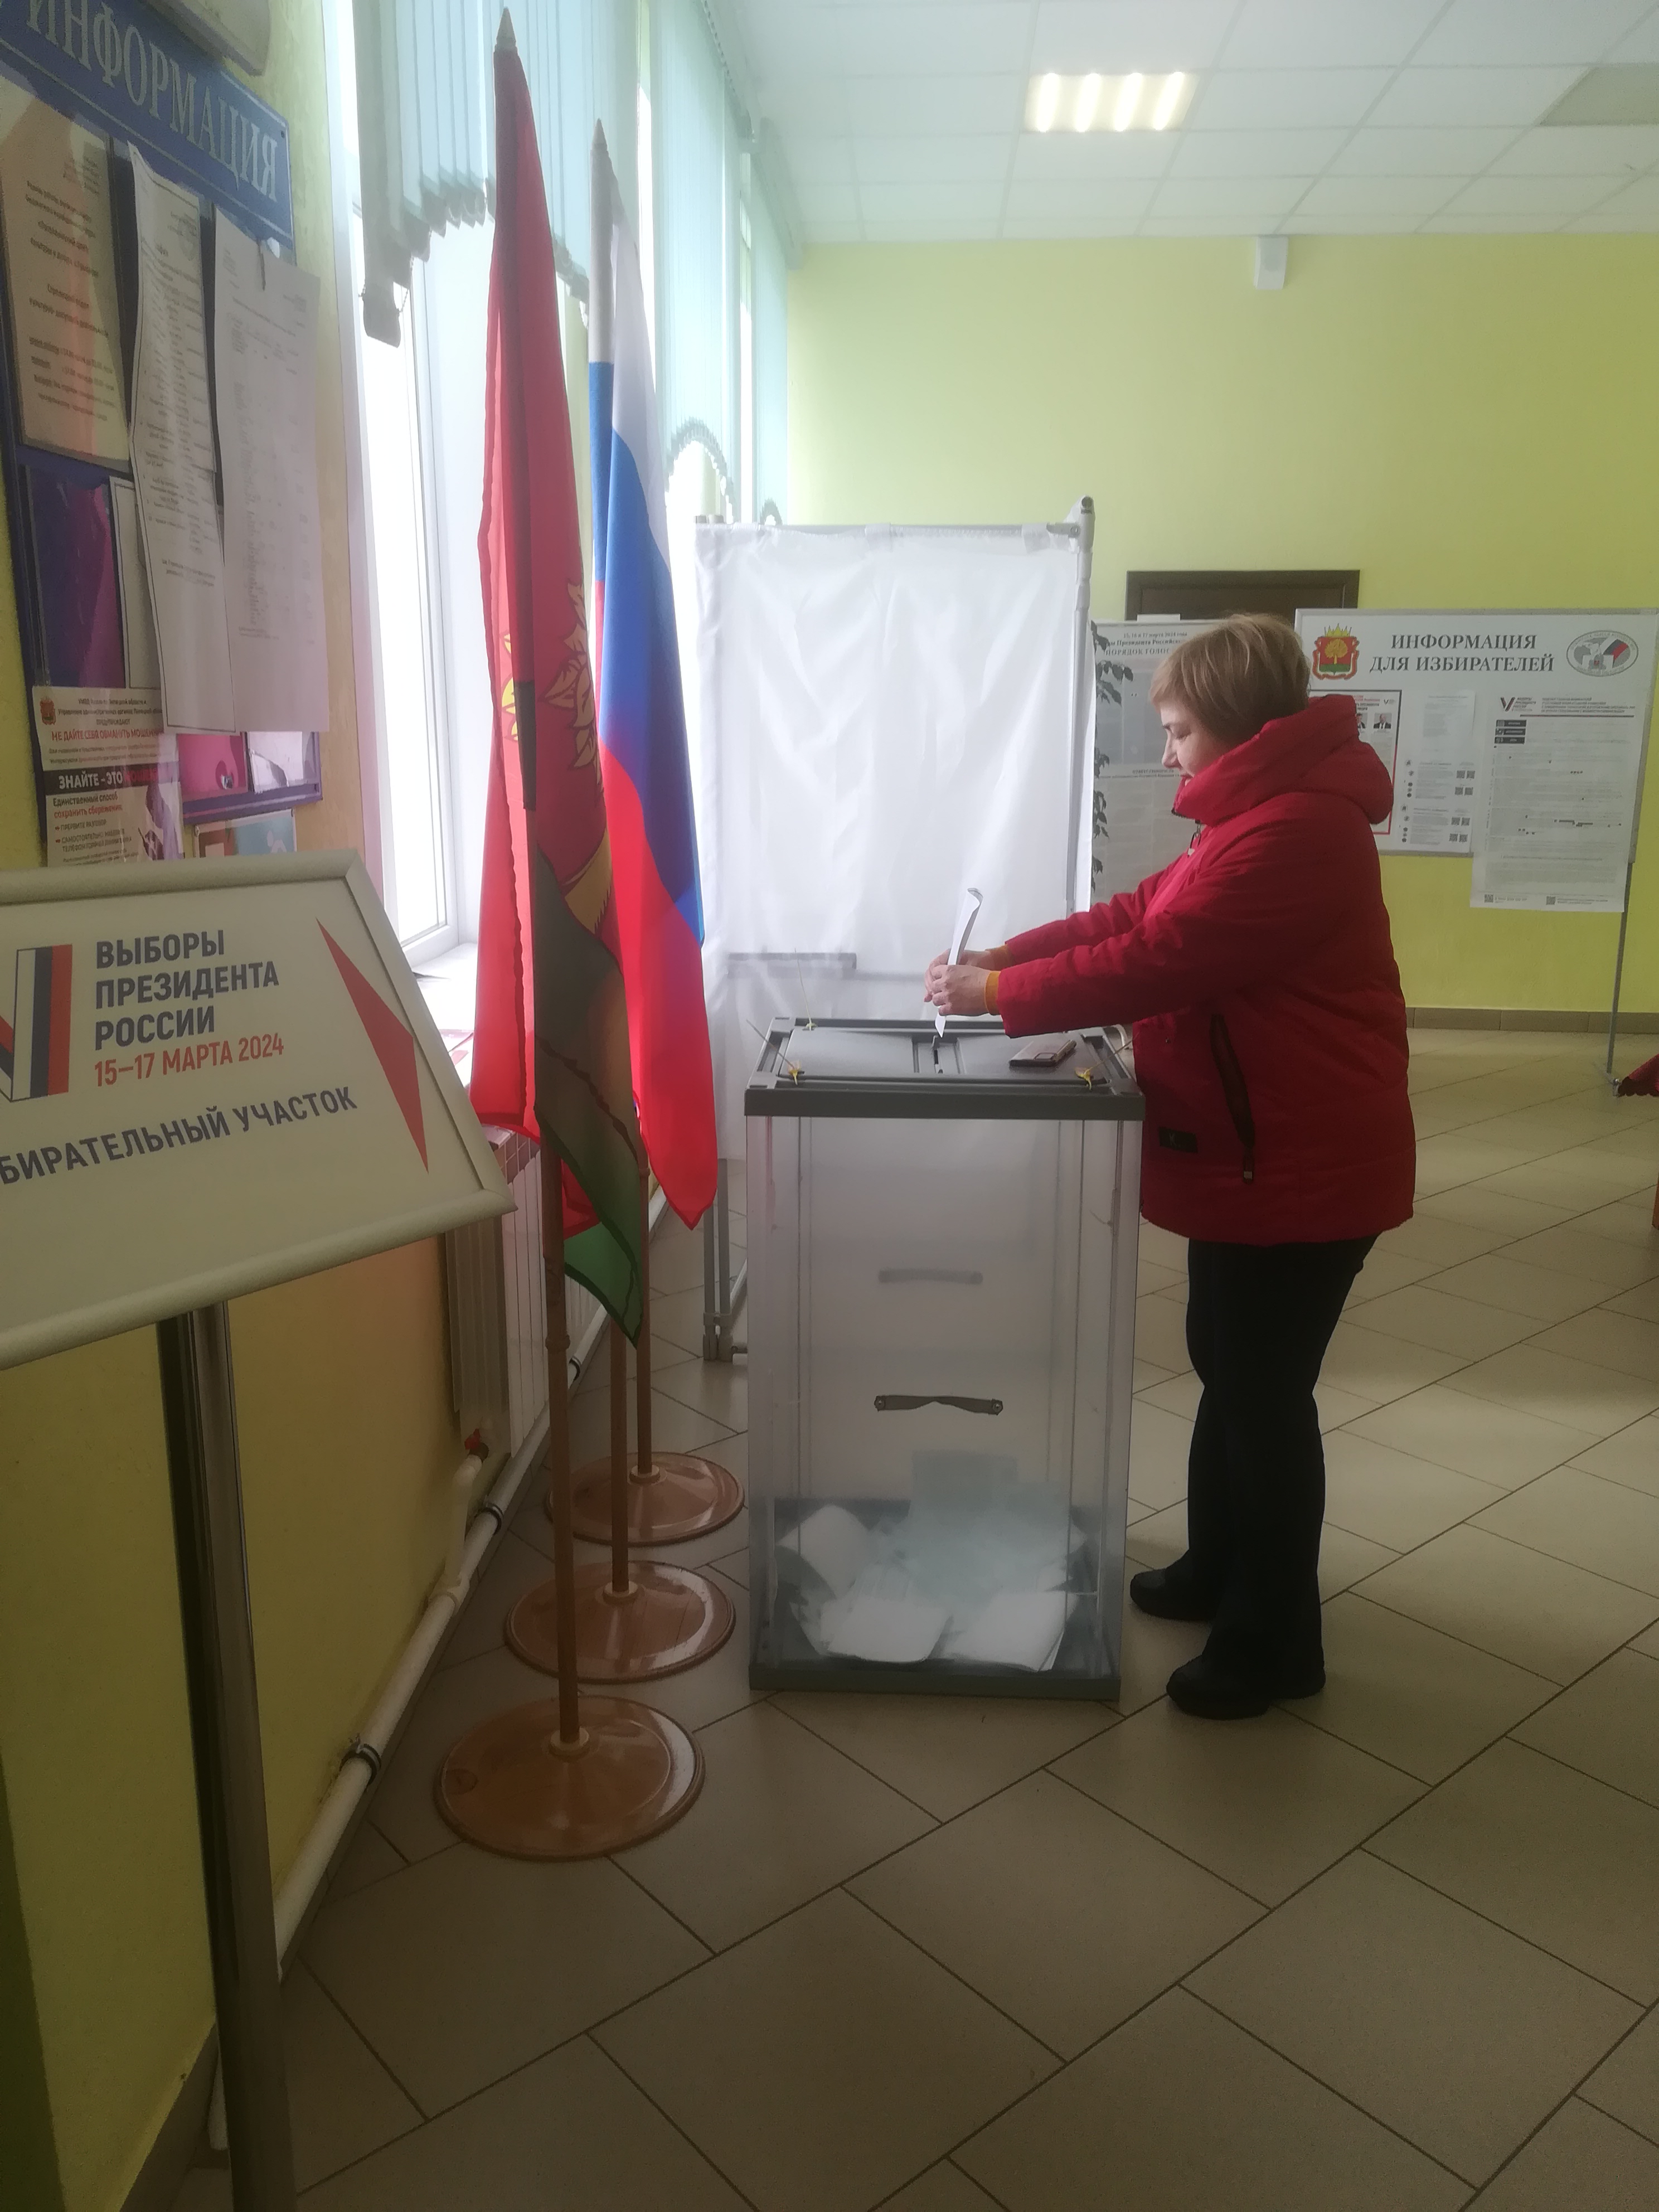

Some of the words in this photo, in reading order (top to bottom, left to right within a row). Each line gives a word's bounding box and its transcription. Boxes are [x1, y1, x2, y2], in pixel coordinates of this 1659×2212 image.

[1391, 634, 1537, 651] ИНФОРМАЦИЯ
[1369, 657, 1410, 674] ДЛЯ
[1416, 653, 1555, 672] ИЗБИРАТЕЛЕЙ
[52, 730, 62, 741] НЕ
[64, 729, 84, 741] ДАЙТЕ
[84, 729, 99, 740] СЕБЯ
[100, 729, 130, 739] ОБМАНУТЬ
[59, 770, 100, 789] ЗНАЙТЕ
[106, 771, 123, 785] ЭТО
[53, 795, 99, 808] Единственный
[99, 791, 118, 802] способ
[54, 808, 88, 819] сохранить
[96, 930, 224, 969] ВЫБОРЫ
[96, 961, 279, 1010] ПРЕЗИДЕНТА
[95, 1005, 214, 1051] РОССИИ
[162, 1040, 233, 1076] МАРТА
[239, 1033, 284, 1062] 2024
[232, 1086, 358, 1132] УЧАСТОК
